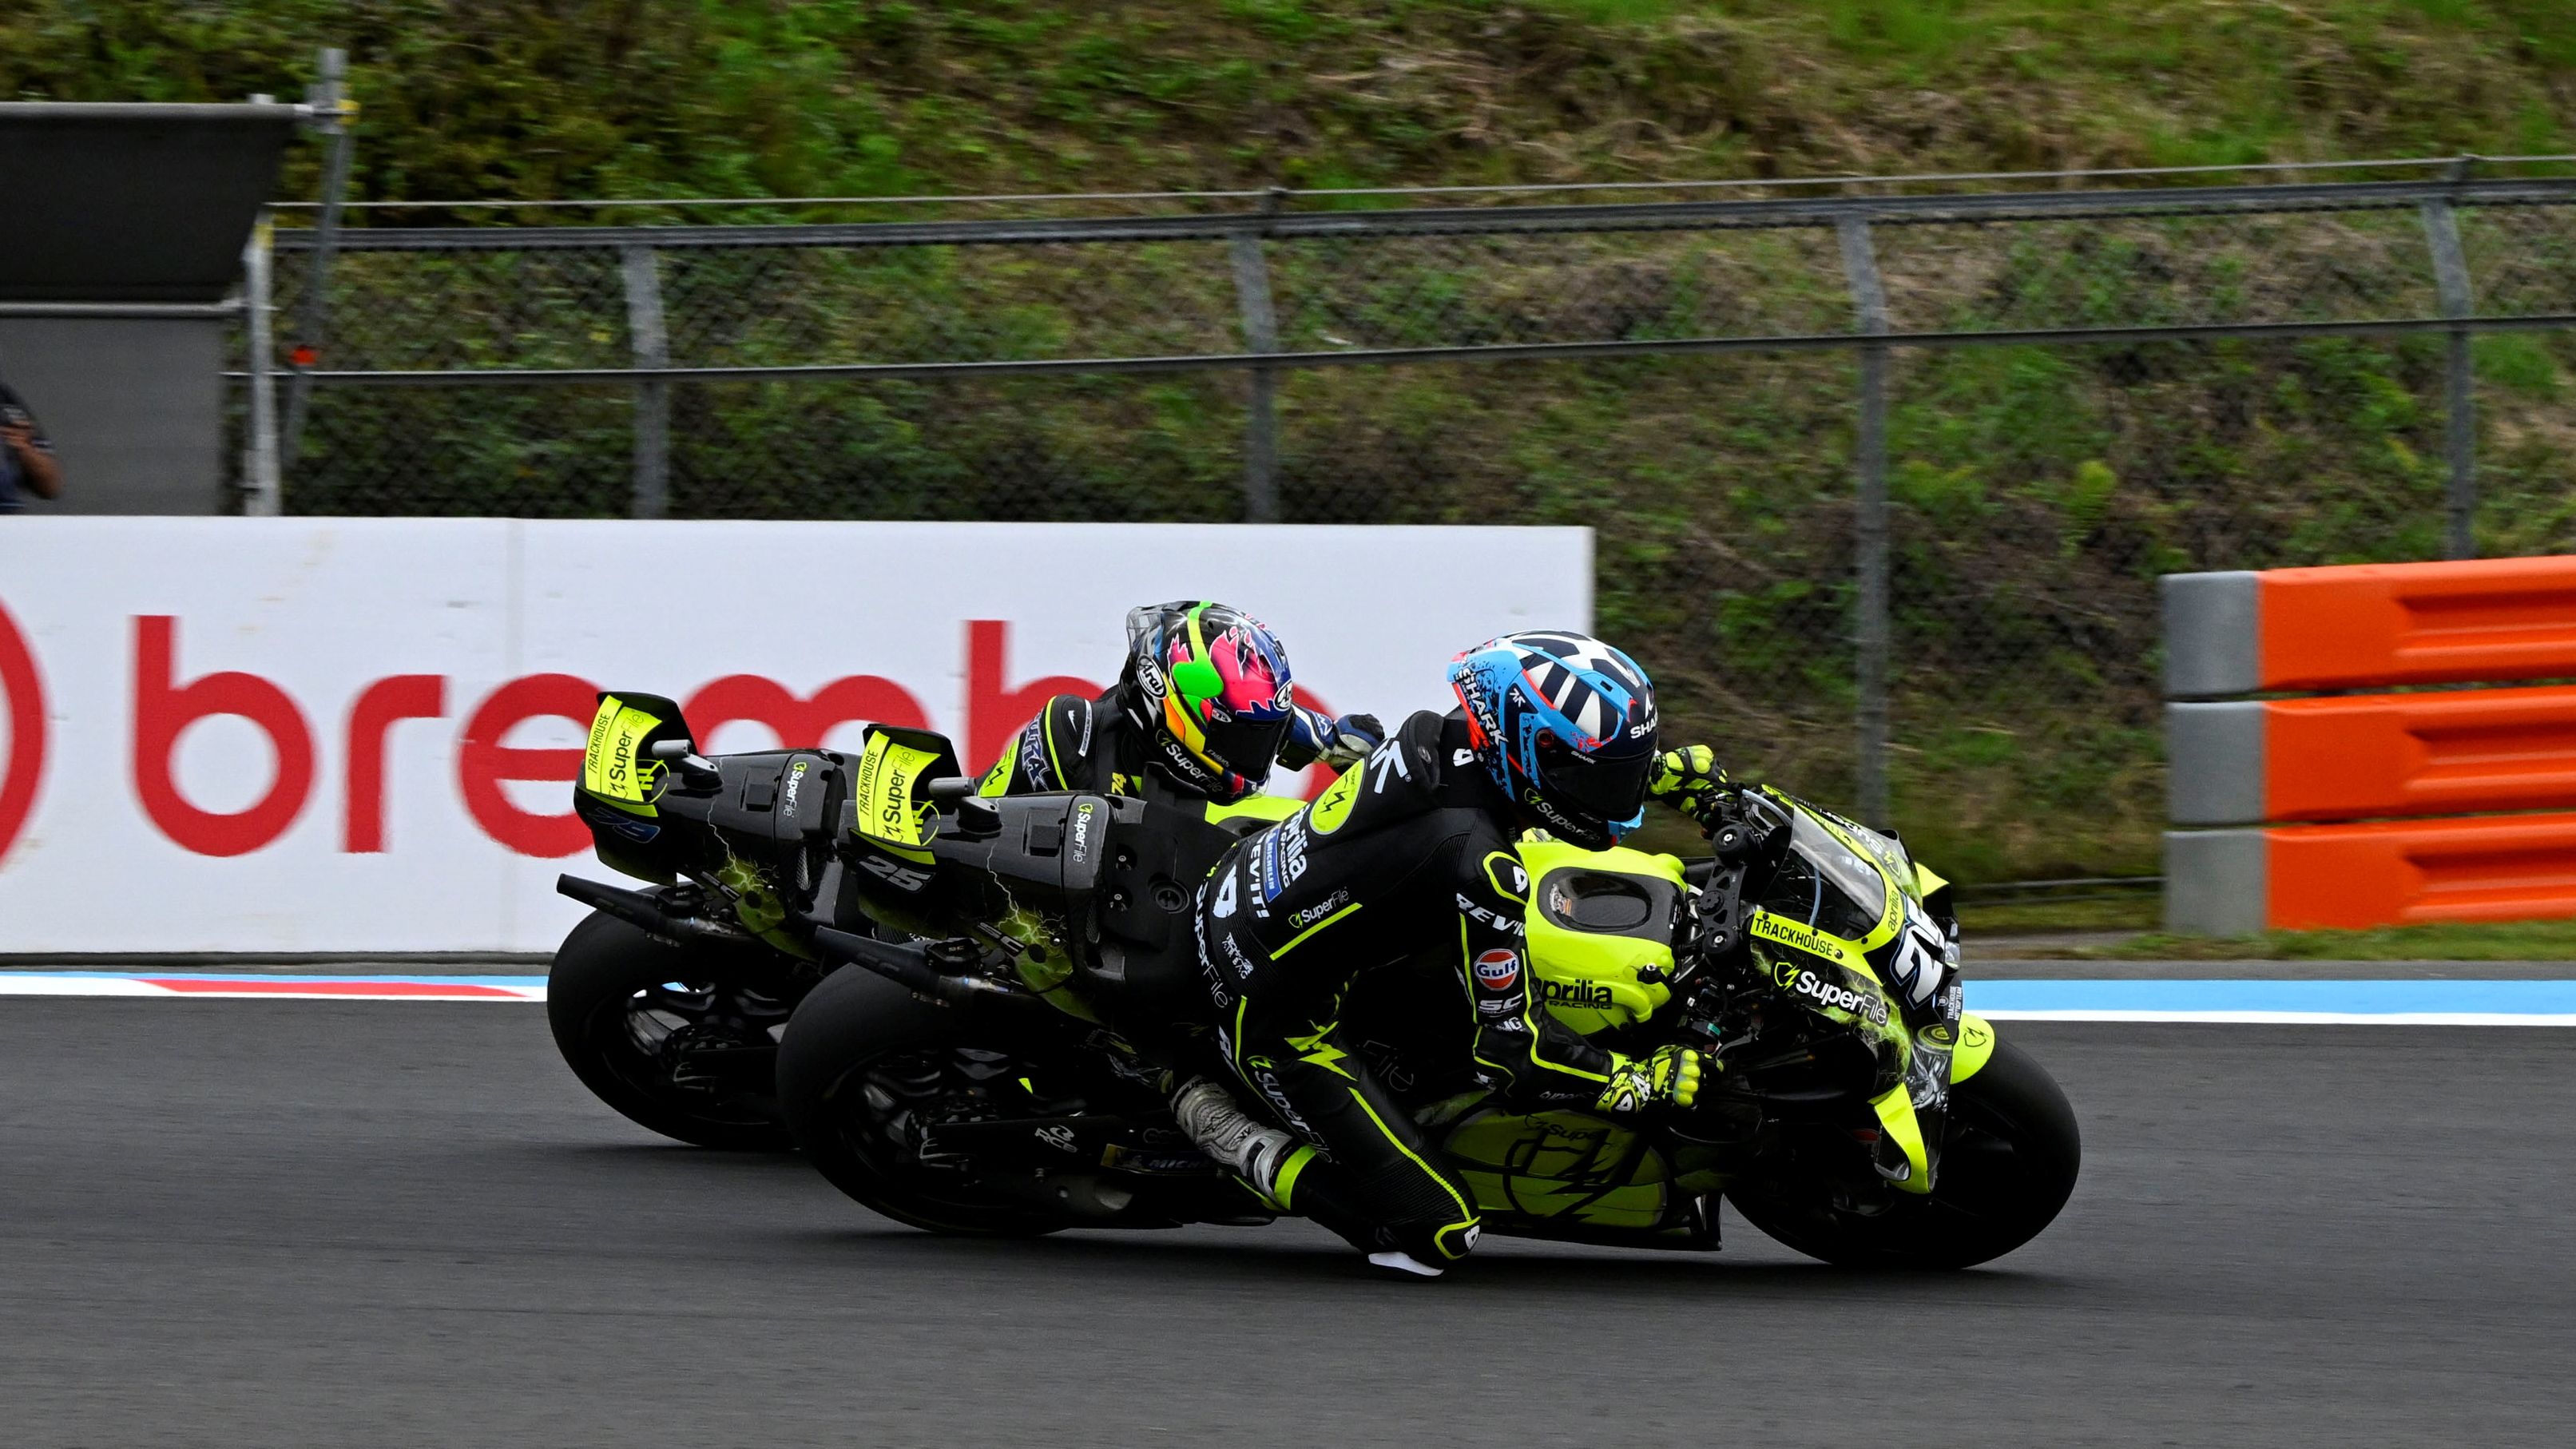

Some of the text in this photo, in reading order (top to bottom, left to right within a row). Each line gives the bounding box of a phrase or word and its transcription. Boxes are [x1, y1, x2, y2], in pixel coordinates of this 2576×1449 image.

[1140, 661, 1164, 696] Arai
[1278, 685, 1292, 708] Ar
[1458, 667, 1509, 745] SHARK
[1629, 710, 1658, 740] SHA
[588, 713, 611, 774] TRACKHOUSE
[609, 711, 645, 782] SuperFile
[1570, 750, 1597, 764] SHARK
[859, 749, 879, 816] TRACKHOUSE
[882, 750, 916, 825] SuperFile
[1166, 744, 1224, 792] SuperFile
[783, 769, 805, 818] SuperFile
[1073, 812, 1092, 863] SuperFile
[857, 855, 935, 891] 25
[1267, 842, 1276, 891] MICHELIN
[1280, 832, 1292, 888] RACING
[1301, 888, 1349, 924] SuperFile
[1888, 891, 1901, 932] aprilia
[1755, 918, 1834, 957] TRACKHOUSE
[1477, 960, 1517, 976] Gulf
[1537, 979, 1613, 1002] prilia
[1549, 998, 1613, 1010] RACING
[1796, 970, 1889, 1026] SuperFile
[1947, 985, 1956, 1020] TRACKHOUSE
